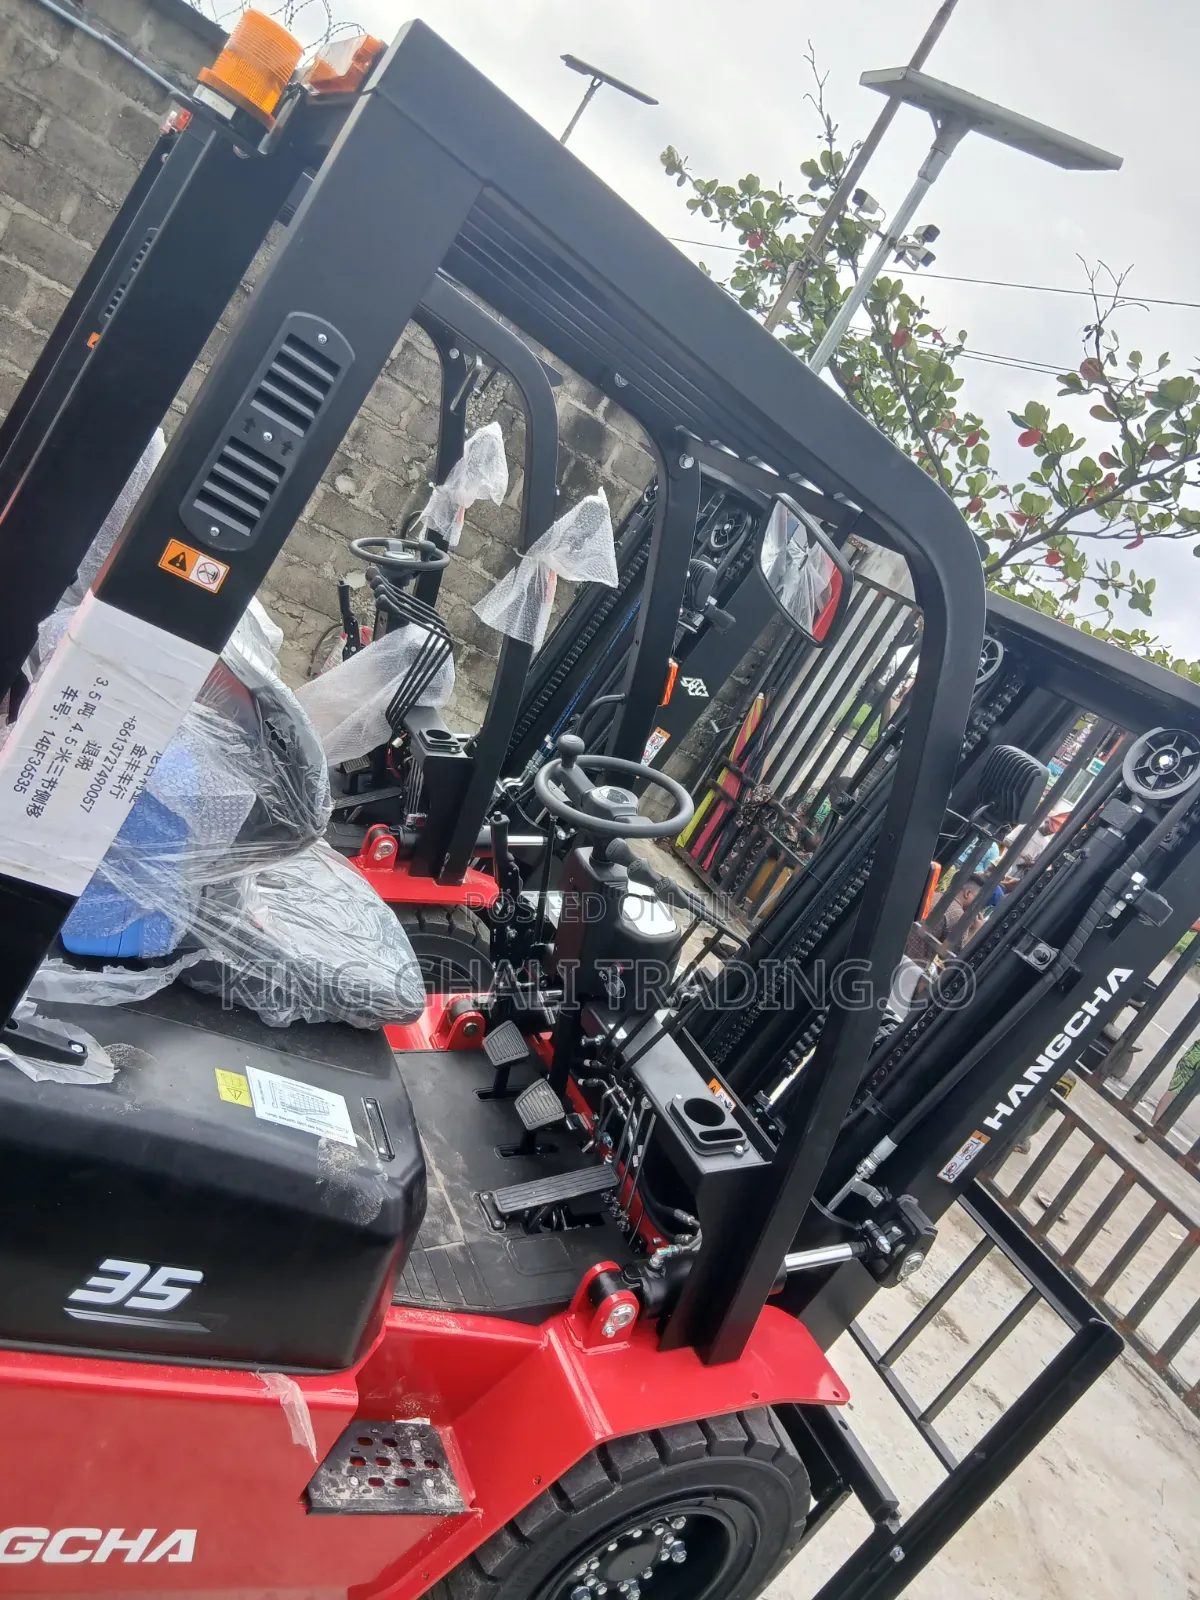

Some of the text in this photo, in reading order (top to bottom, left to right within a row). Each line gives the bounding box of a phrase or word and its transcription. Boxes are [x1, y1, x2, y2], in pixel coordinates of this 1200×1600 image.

[74, 740, 100, 772] 退税
[79, 716, 138, 814] +8613727490057
[108, 744, 148, 800] 金丰车行
[983, 967, 1135, 1131] HANGCHA
[67, 1258, 205, 1312] 35
[0, 1526, 198, 1564] GCHA
